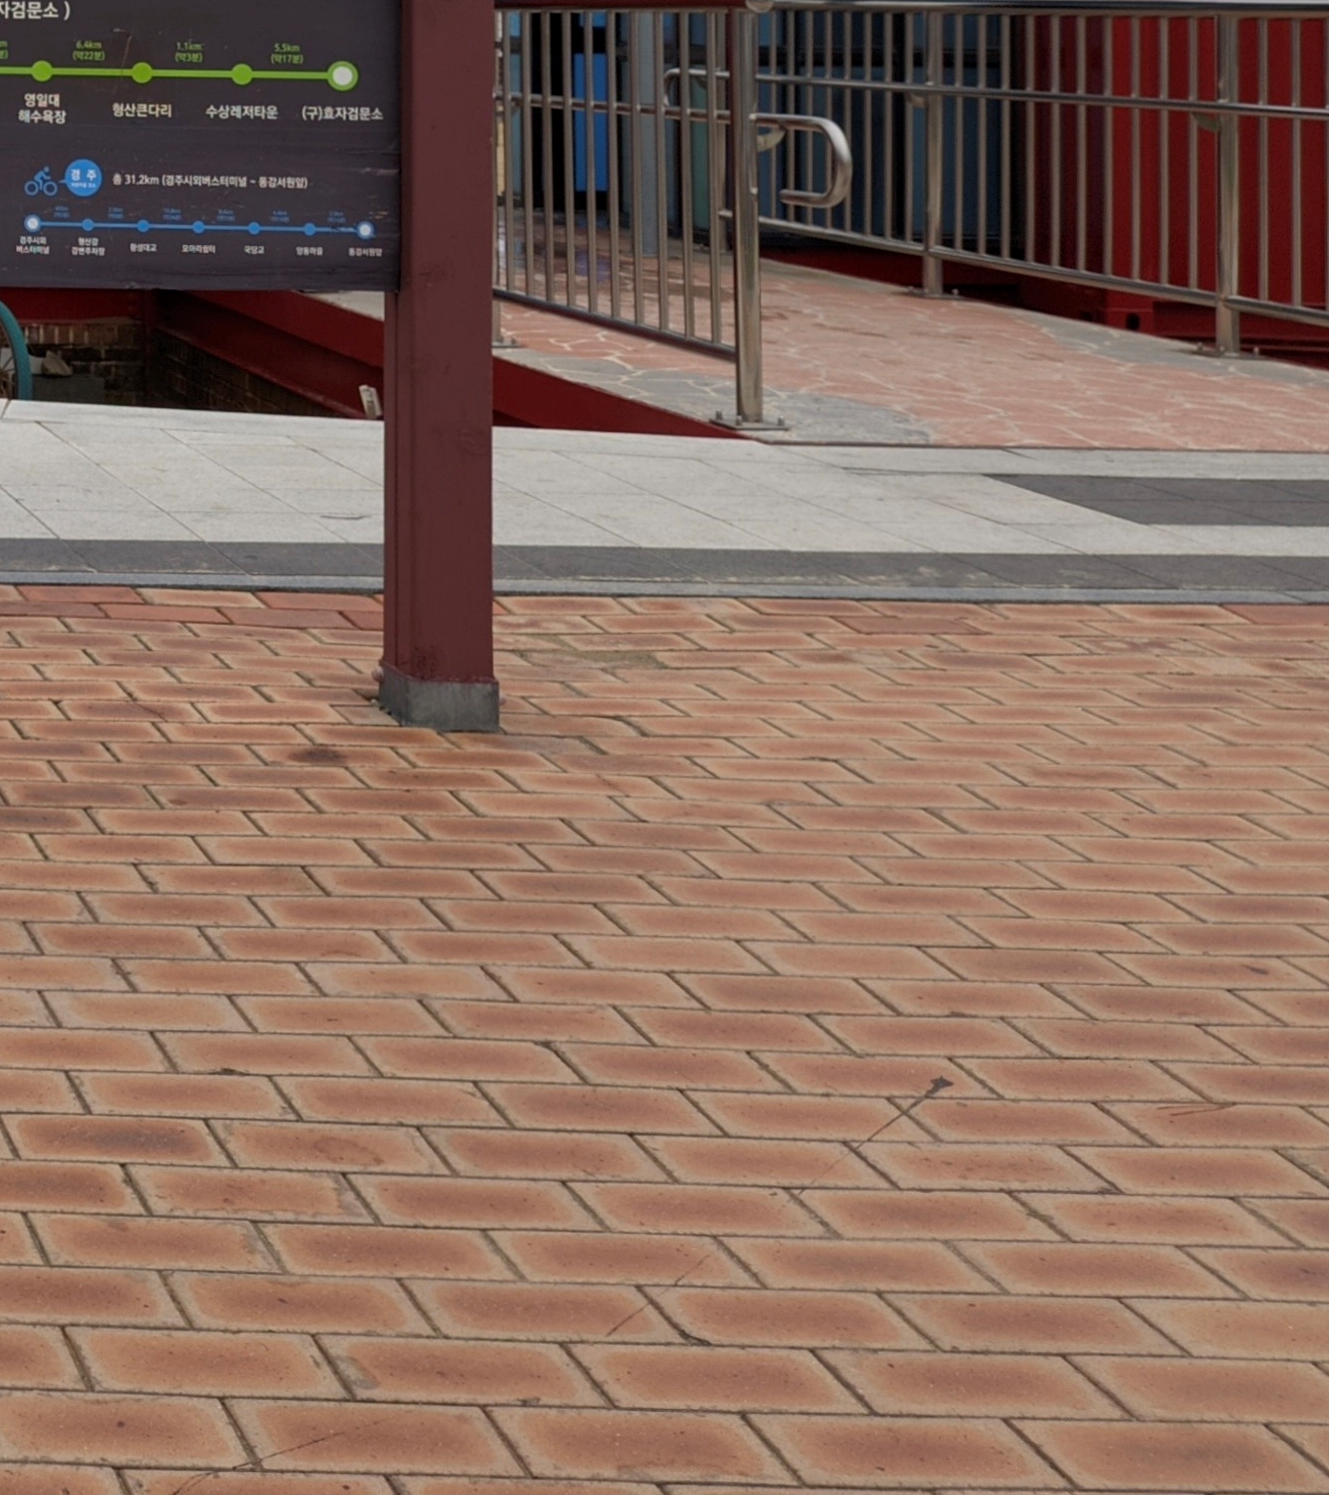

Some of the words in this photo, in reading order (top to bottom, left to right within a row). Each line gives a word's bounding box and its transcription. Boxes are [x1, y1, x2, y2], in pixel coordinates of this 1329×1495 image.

[24, 93, 60, 107] 영일대
[18, 109, 66, 124] 해수욕장
[112, 103, 172, 118] 형산큰다리
[206, 105, 278, 120] 수상레저타운
[301, 106, 384, 121] (구)효자검문소
[112, 173, 122, 186] 총
[124, 174, 159, 186] 31.2km
[161, 174, 247, 188] (경주시외버스터미널
